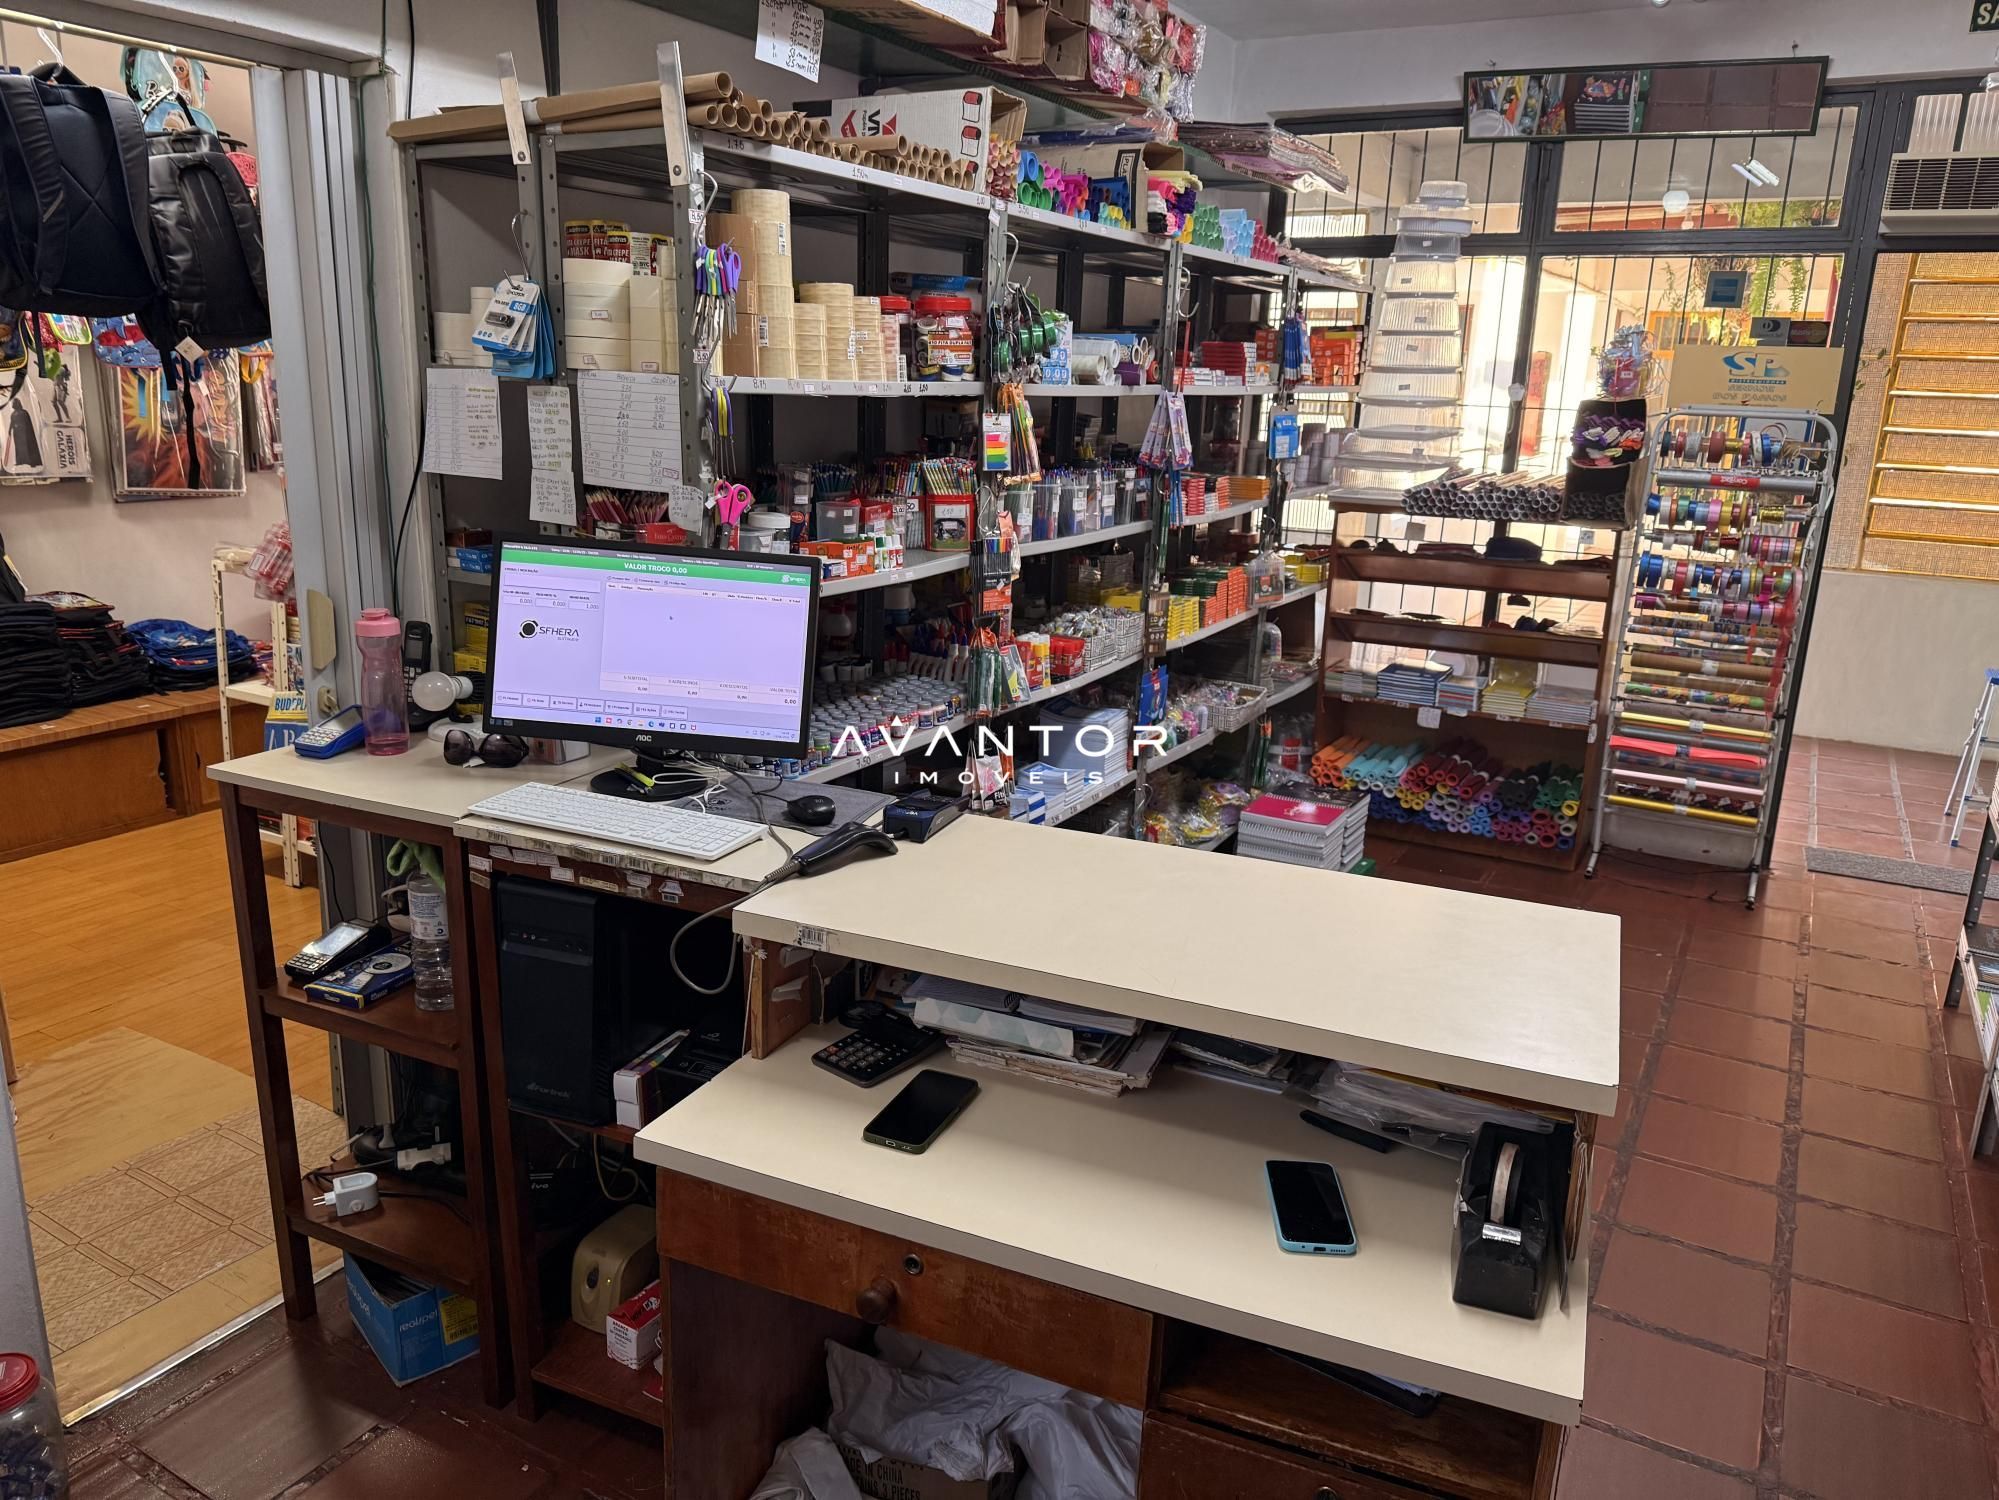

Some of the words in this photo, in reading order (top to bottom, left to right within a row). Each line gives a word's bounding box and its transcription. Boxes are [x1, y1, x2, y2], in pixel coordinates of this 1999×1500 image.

[56, 430, 67, 469] GALAXIA
[624, 562, 647, 571] VALOR
[648, 564, 671, 573] TROCO
[539, 626, 580, 638] SFHERA
[636, 734, 652, 742] AOC
[876, 1463, 904, 1485] CHINA
